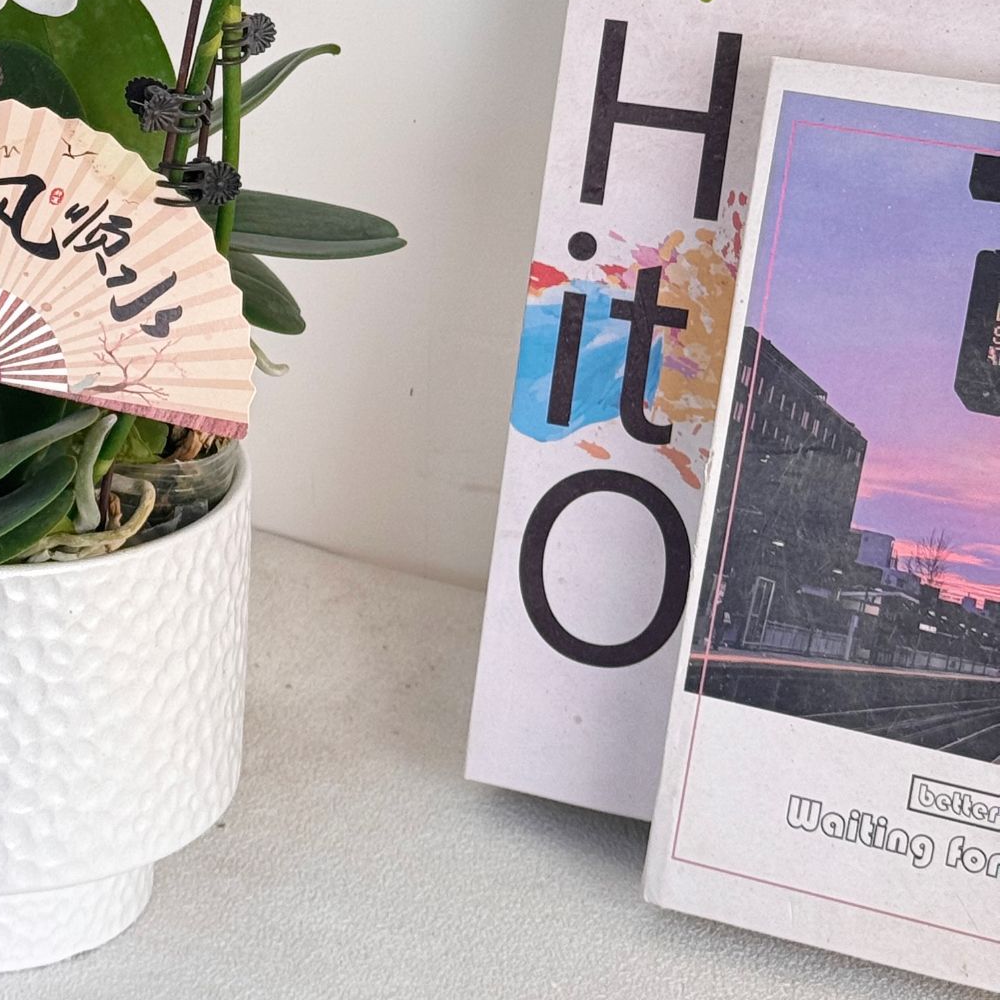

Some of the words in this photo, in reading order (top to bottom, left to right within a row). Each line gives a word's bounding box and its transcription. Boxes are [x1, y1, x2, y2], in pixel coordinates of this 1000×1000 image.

[546, 231, 689, 446] it
[786, 794, 935, 869] Waiting
[945, 836, 1000, 878] for
[918, 783, 1000, 823] better
